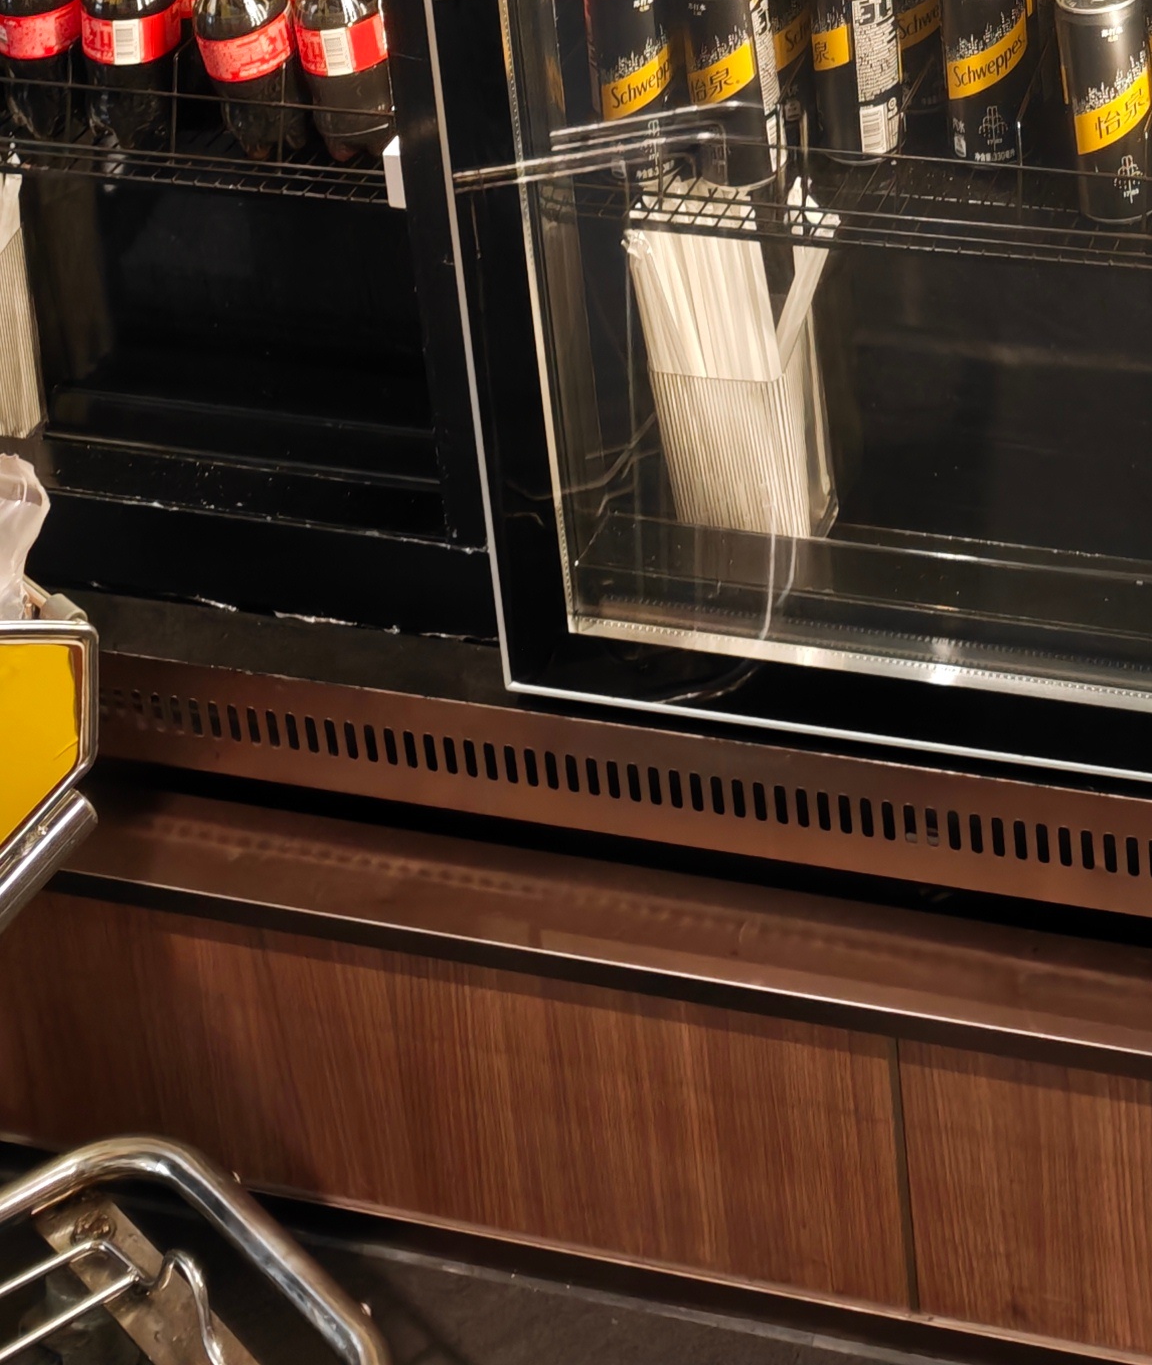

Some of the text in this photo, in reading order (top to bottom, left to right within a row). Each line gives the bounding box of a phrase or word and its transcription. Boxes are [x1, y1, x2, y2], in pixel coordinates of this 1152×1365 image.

[899, 6, 941, 40] Schwe
[610, 60, 670, 110] Schwepp
[690, 67, 735, 103] 怡泉
[953, 36, 1024, 88] Schweppes
[1094, 86, 1147, 141] 怡泉
